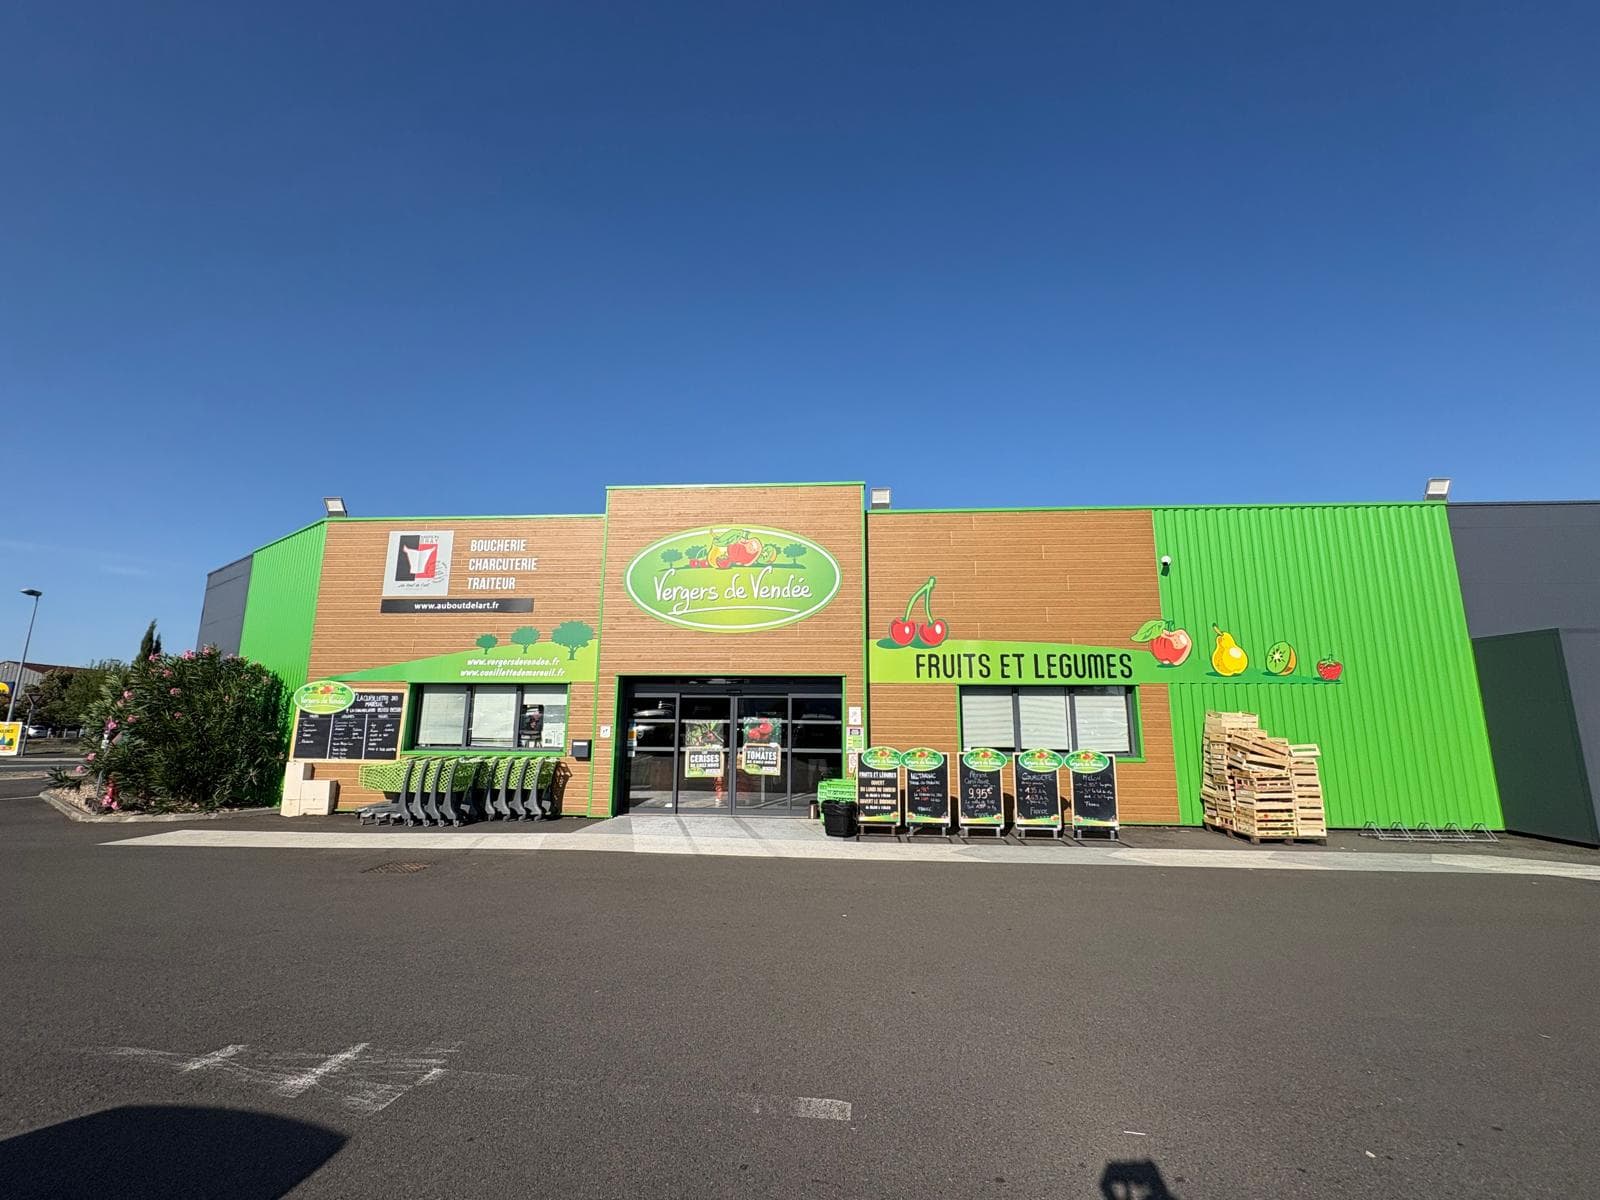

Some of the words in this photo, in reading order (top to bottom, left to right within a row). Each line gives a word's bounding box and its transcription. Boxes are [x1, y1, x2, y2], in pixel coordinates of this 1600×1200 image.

[470, 539, 527, 552] BOUCHERIE
[468, 557, 538, 571] CHARCUTERIE
[467, 577, 516, 590] TRAITEUR
[654, 568, 719, 614] Vergers
[724, 573, 748, 599] de
[750, 565, 812, 599] Vendée
[414, 601, 500, 610] www.auboutdelart.fr
[915, 653, 991, 679] FRUITS
[1000, 653, 1024, 679] ET
[1034, 653, 1133, 679] LEGUMES
[690, 755, 719, 763] CERISES
[747, 751, 776, 760] TOMATES
